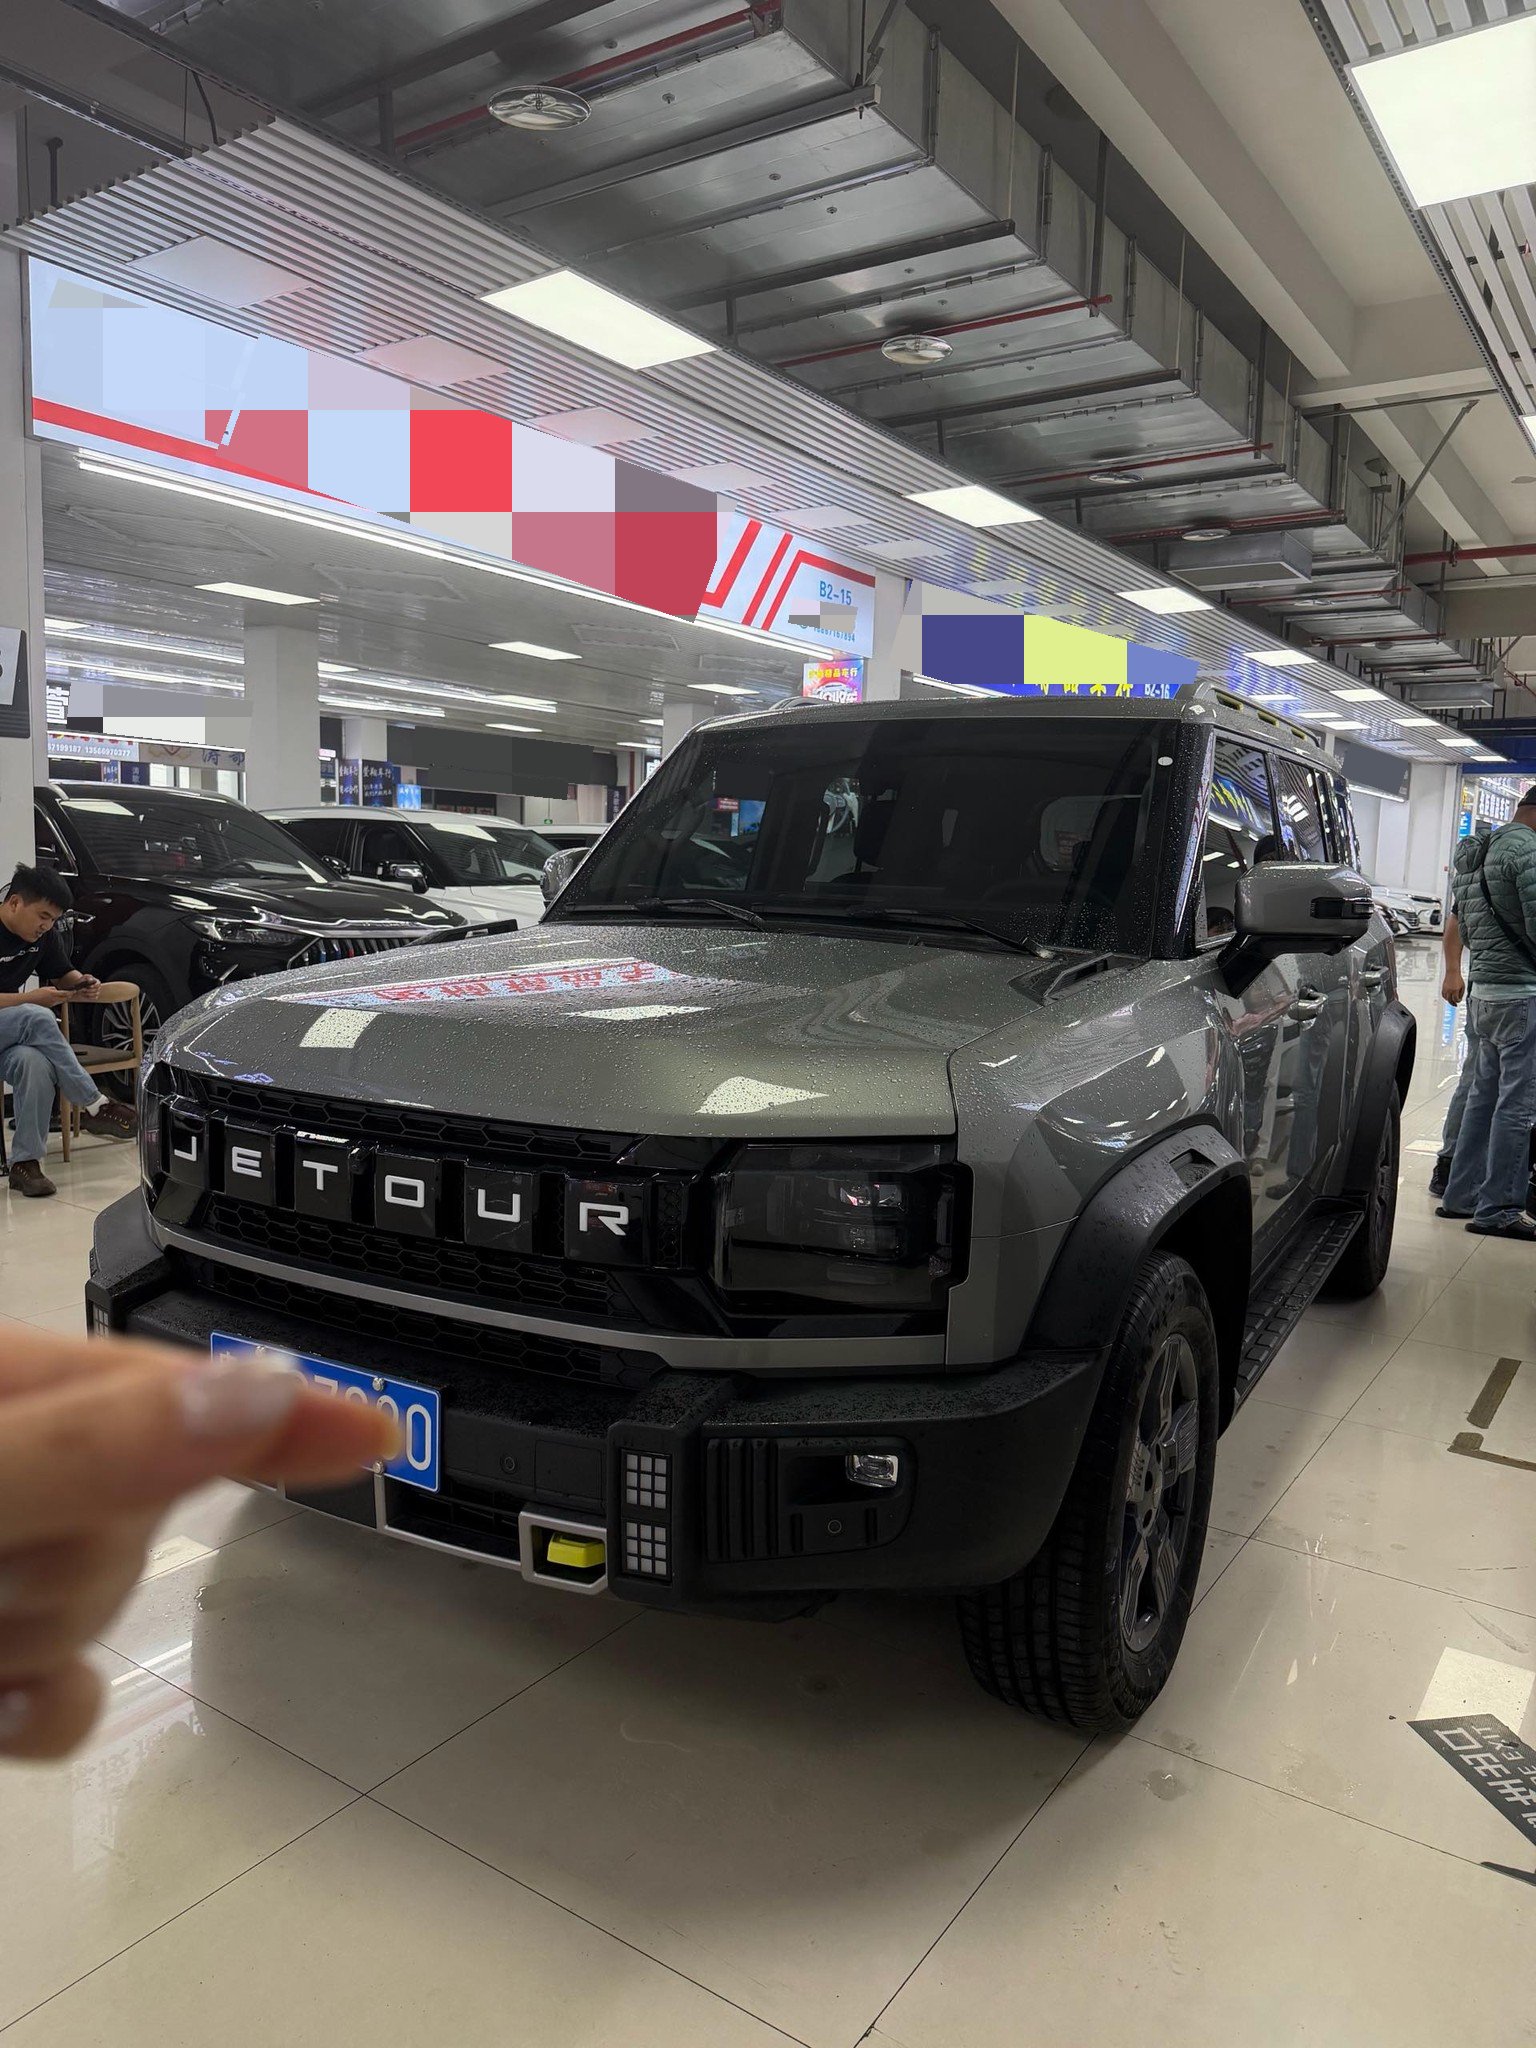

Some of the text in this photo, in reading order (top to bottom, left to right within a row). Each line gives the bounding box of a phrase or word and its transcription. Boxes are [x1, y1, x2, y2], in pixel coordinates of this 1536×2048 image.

[819, 580, 852, 606] B2-15
[174, 1135, 629, 1237] JETOUR
[1472, 1725, 1525, 1761] EXIT
